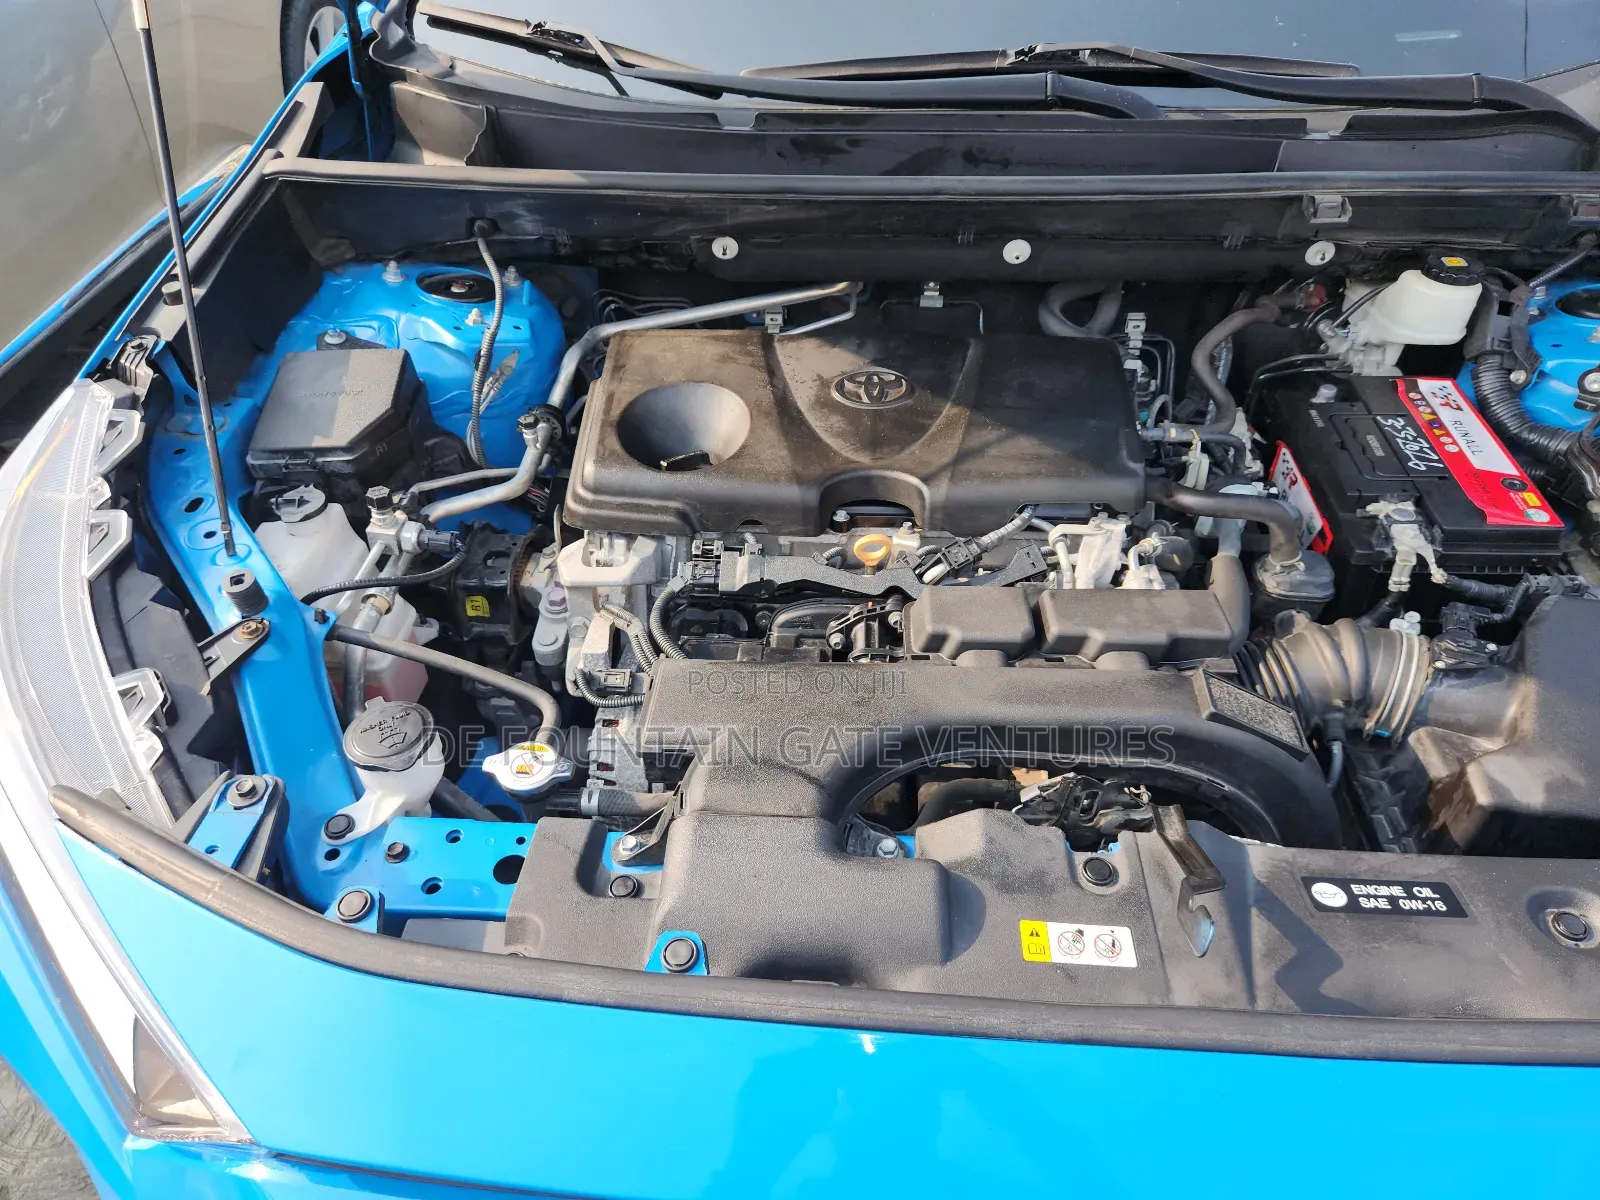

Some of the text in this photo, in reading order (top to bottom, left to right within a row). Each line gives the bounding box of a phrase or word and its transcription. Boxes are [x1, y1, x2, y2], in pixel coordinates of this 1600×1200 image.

[1449, 419, 1484, 456] RUNALL
[1350, 884, 1440, 898] ENGINE OIL
[1358, 897, 1448, 911] SAE 0W-16
